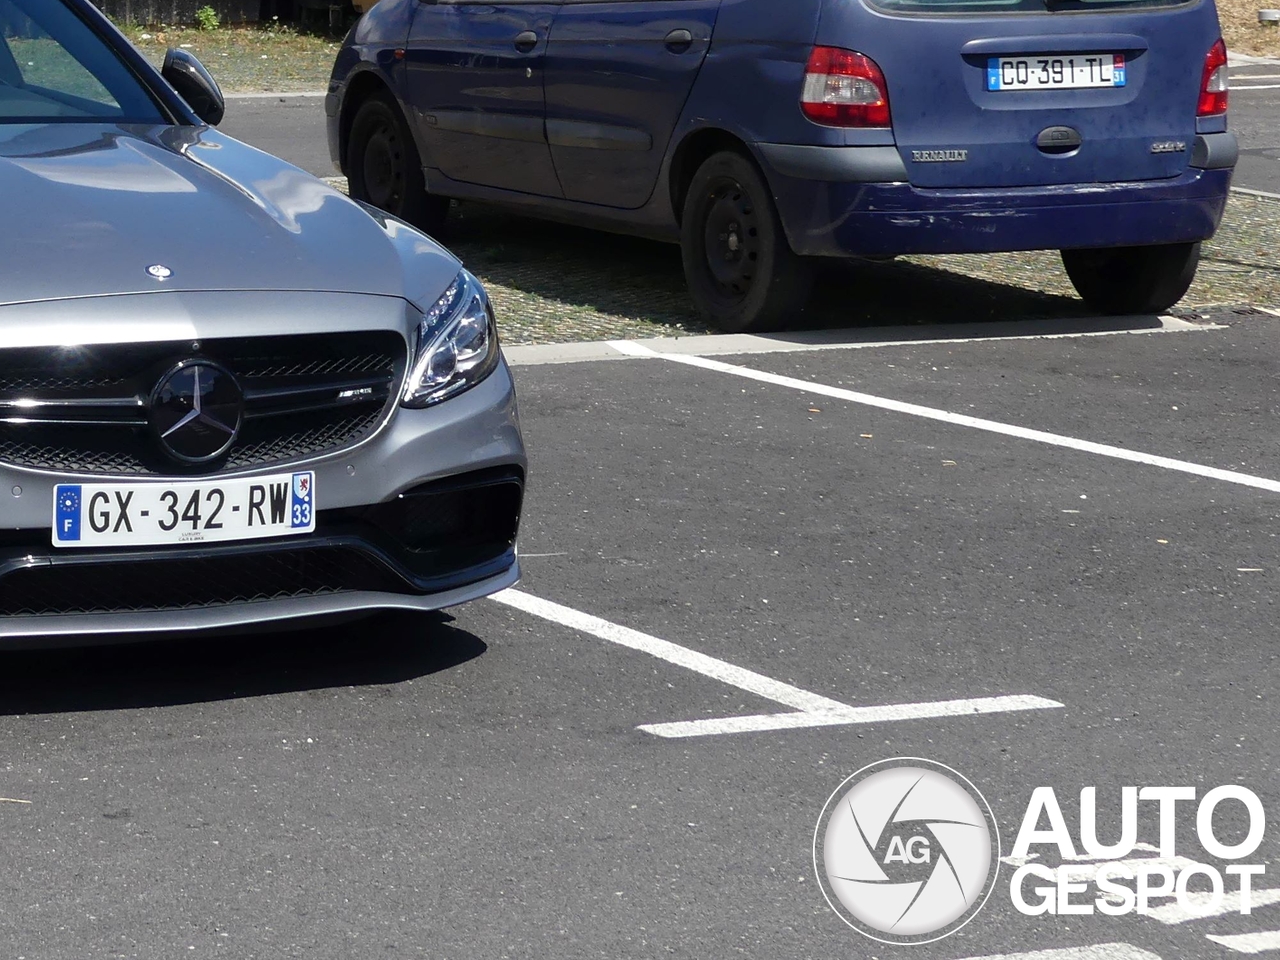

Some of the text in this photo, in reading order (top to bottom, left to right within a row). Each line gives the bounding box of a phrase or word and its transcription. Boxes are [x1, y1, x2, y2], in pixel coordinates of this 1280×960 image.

[1001, 58, 1112, 85] CQ-391-TL
[1113, 71, 1125, 82] 31
[990, 76, 997, 85] F
[911, 150, 968, 162] RENAULT
[88, 482, 289, 533] GX-342-RW
[292, 503, 311, 525] 33
[63, 519, 73, 532] F
